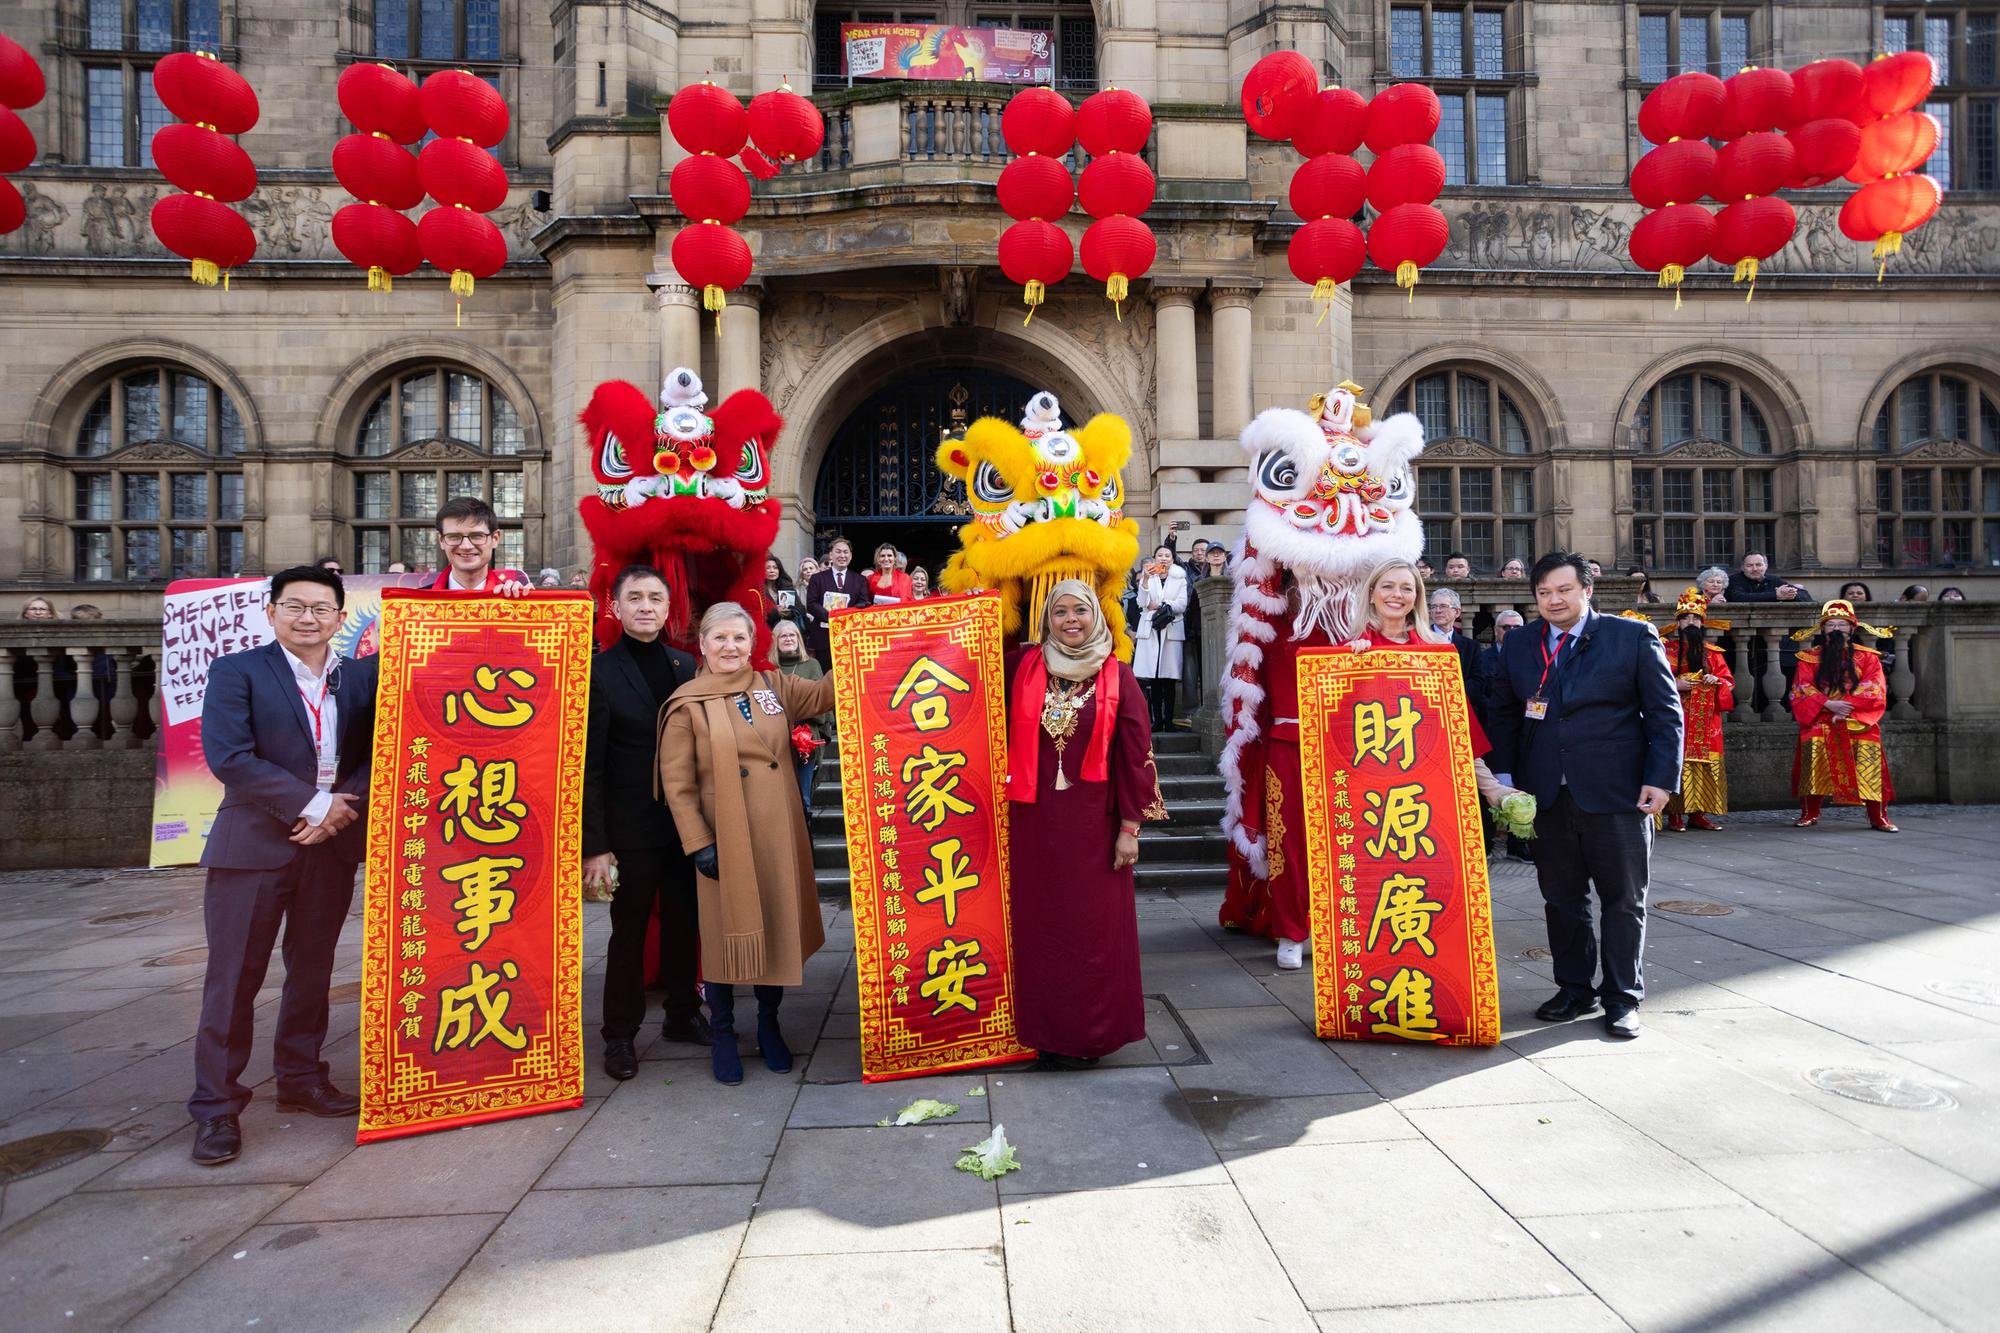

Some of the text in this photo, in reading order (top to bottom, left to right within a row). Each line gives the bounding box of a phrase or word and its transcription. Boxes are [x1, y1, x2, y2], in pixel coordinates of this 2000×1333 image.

[846, 29, 871, 39] YEAR
[892, 26, 920, 38] HORSE
[163, 590, 272, 625] SHEFFIELD
[163, 613, 248, 649] LUNAR
[171, 669, 209, 688] NEW
[889, 655, 988, 1017] 合家平安
[434, 663, 537, 1055] 心想事成
[1352, 696, 1450, 1041] 財源廣進
